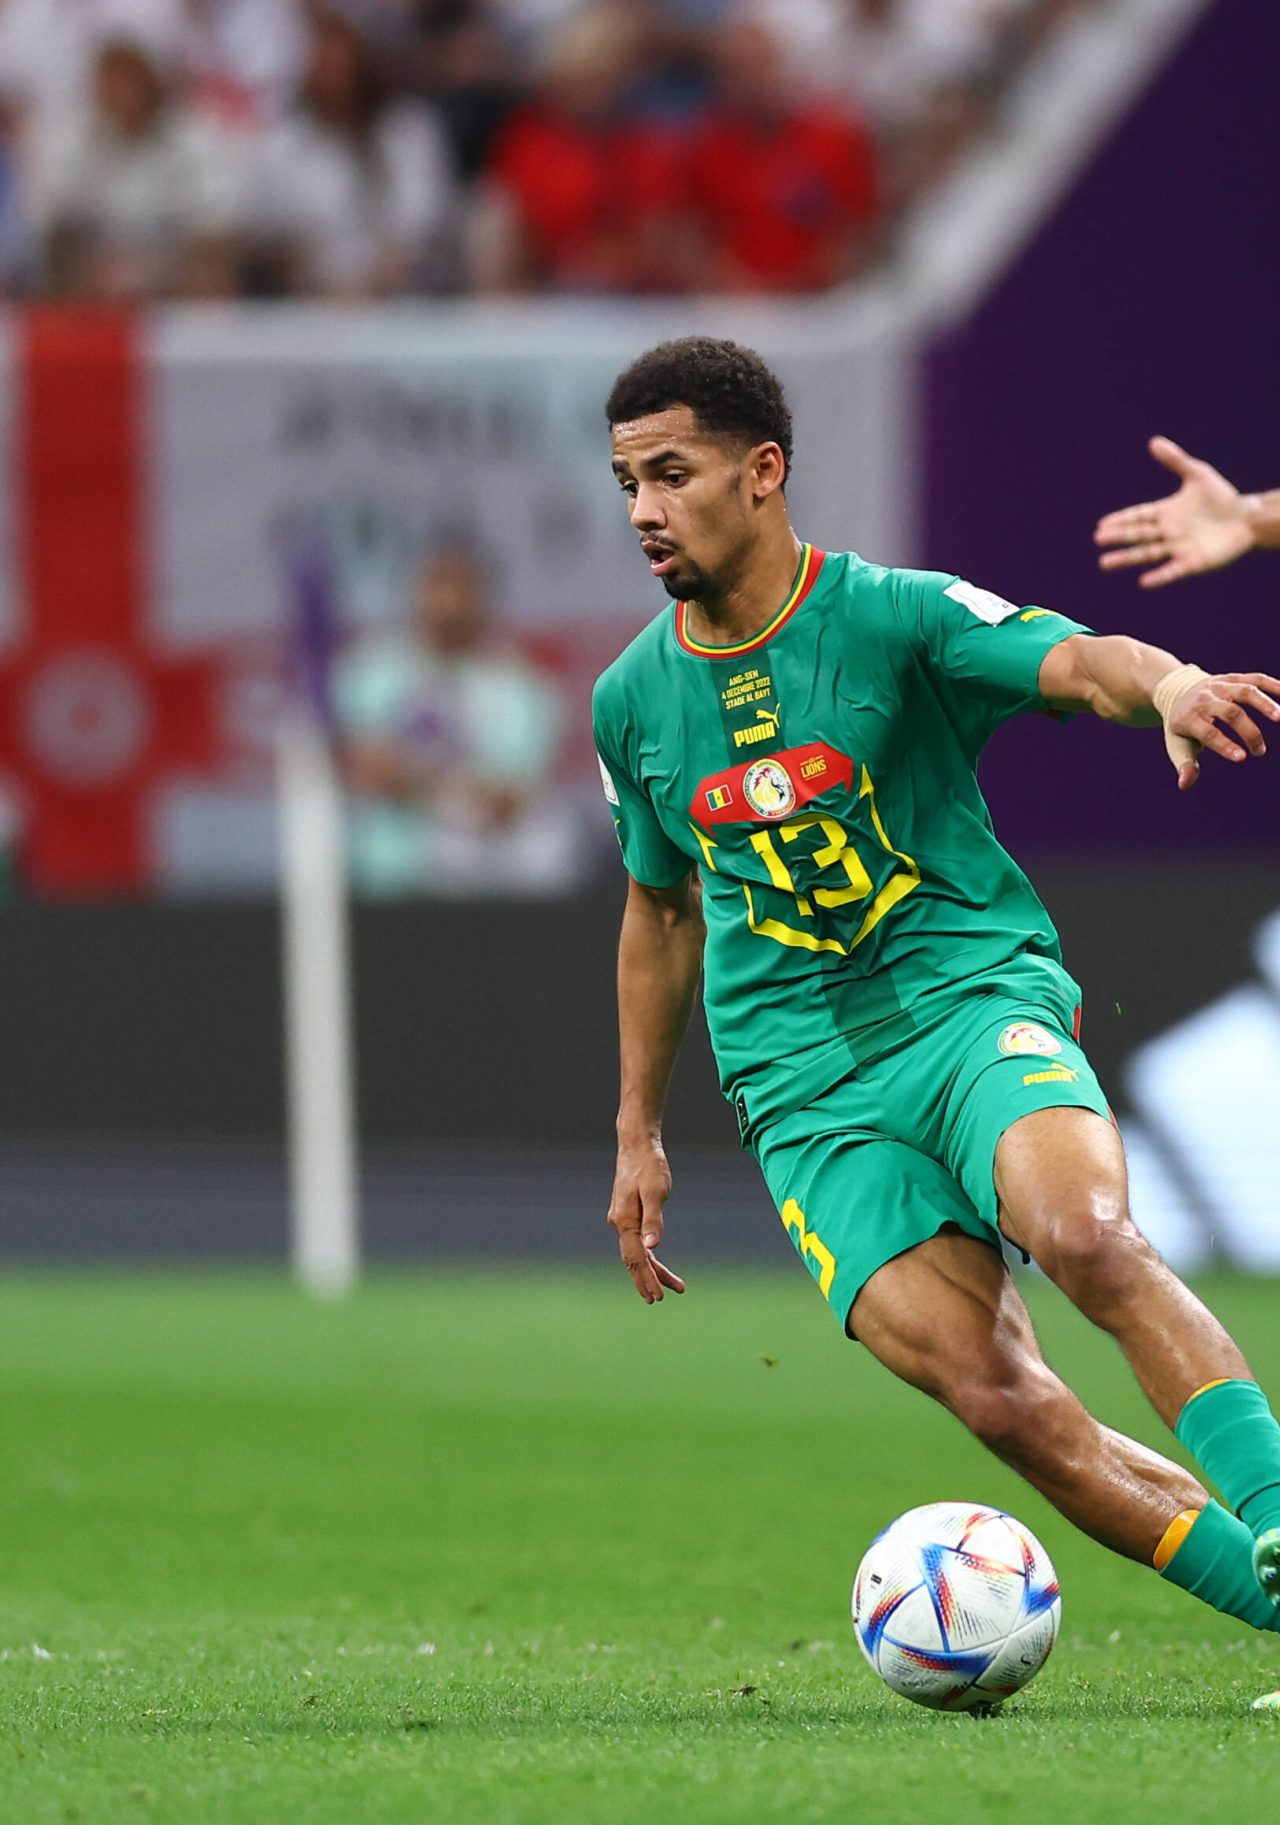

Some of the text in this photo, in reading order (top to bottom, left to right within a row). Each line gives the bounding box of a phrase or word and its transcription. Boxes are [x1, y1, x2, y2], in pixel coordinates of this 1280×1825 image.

[755, 676, 771, 689] 2022
[725, 688, 771, 710] STADE AL BAYT
[733, 721, 776, 748] PUMA
[800, 759, 827, 778] LIONS
[749, 812, 874, 917] 13
[1023, 1070, 1073, 1086] PUMA
